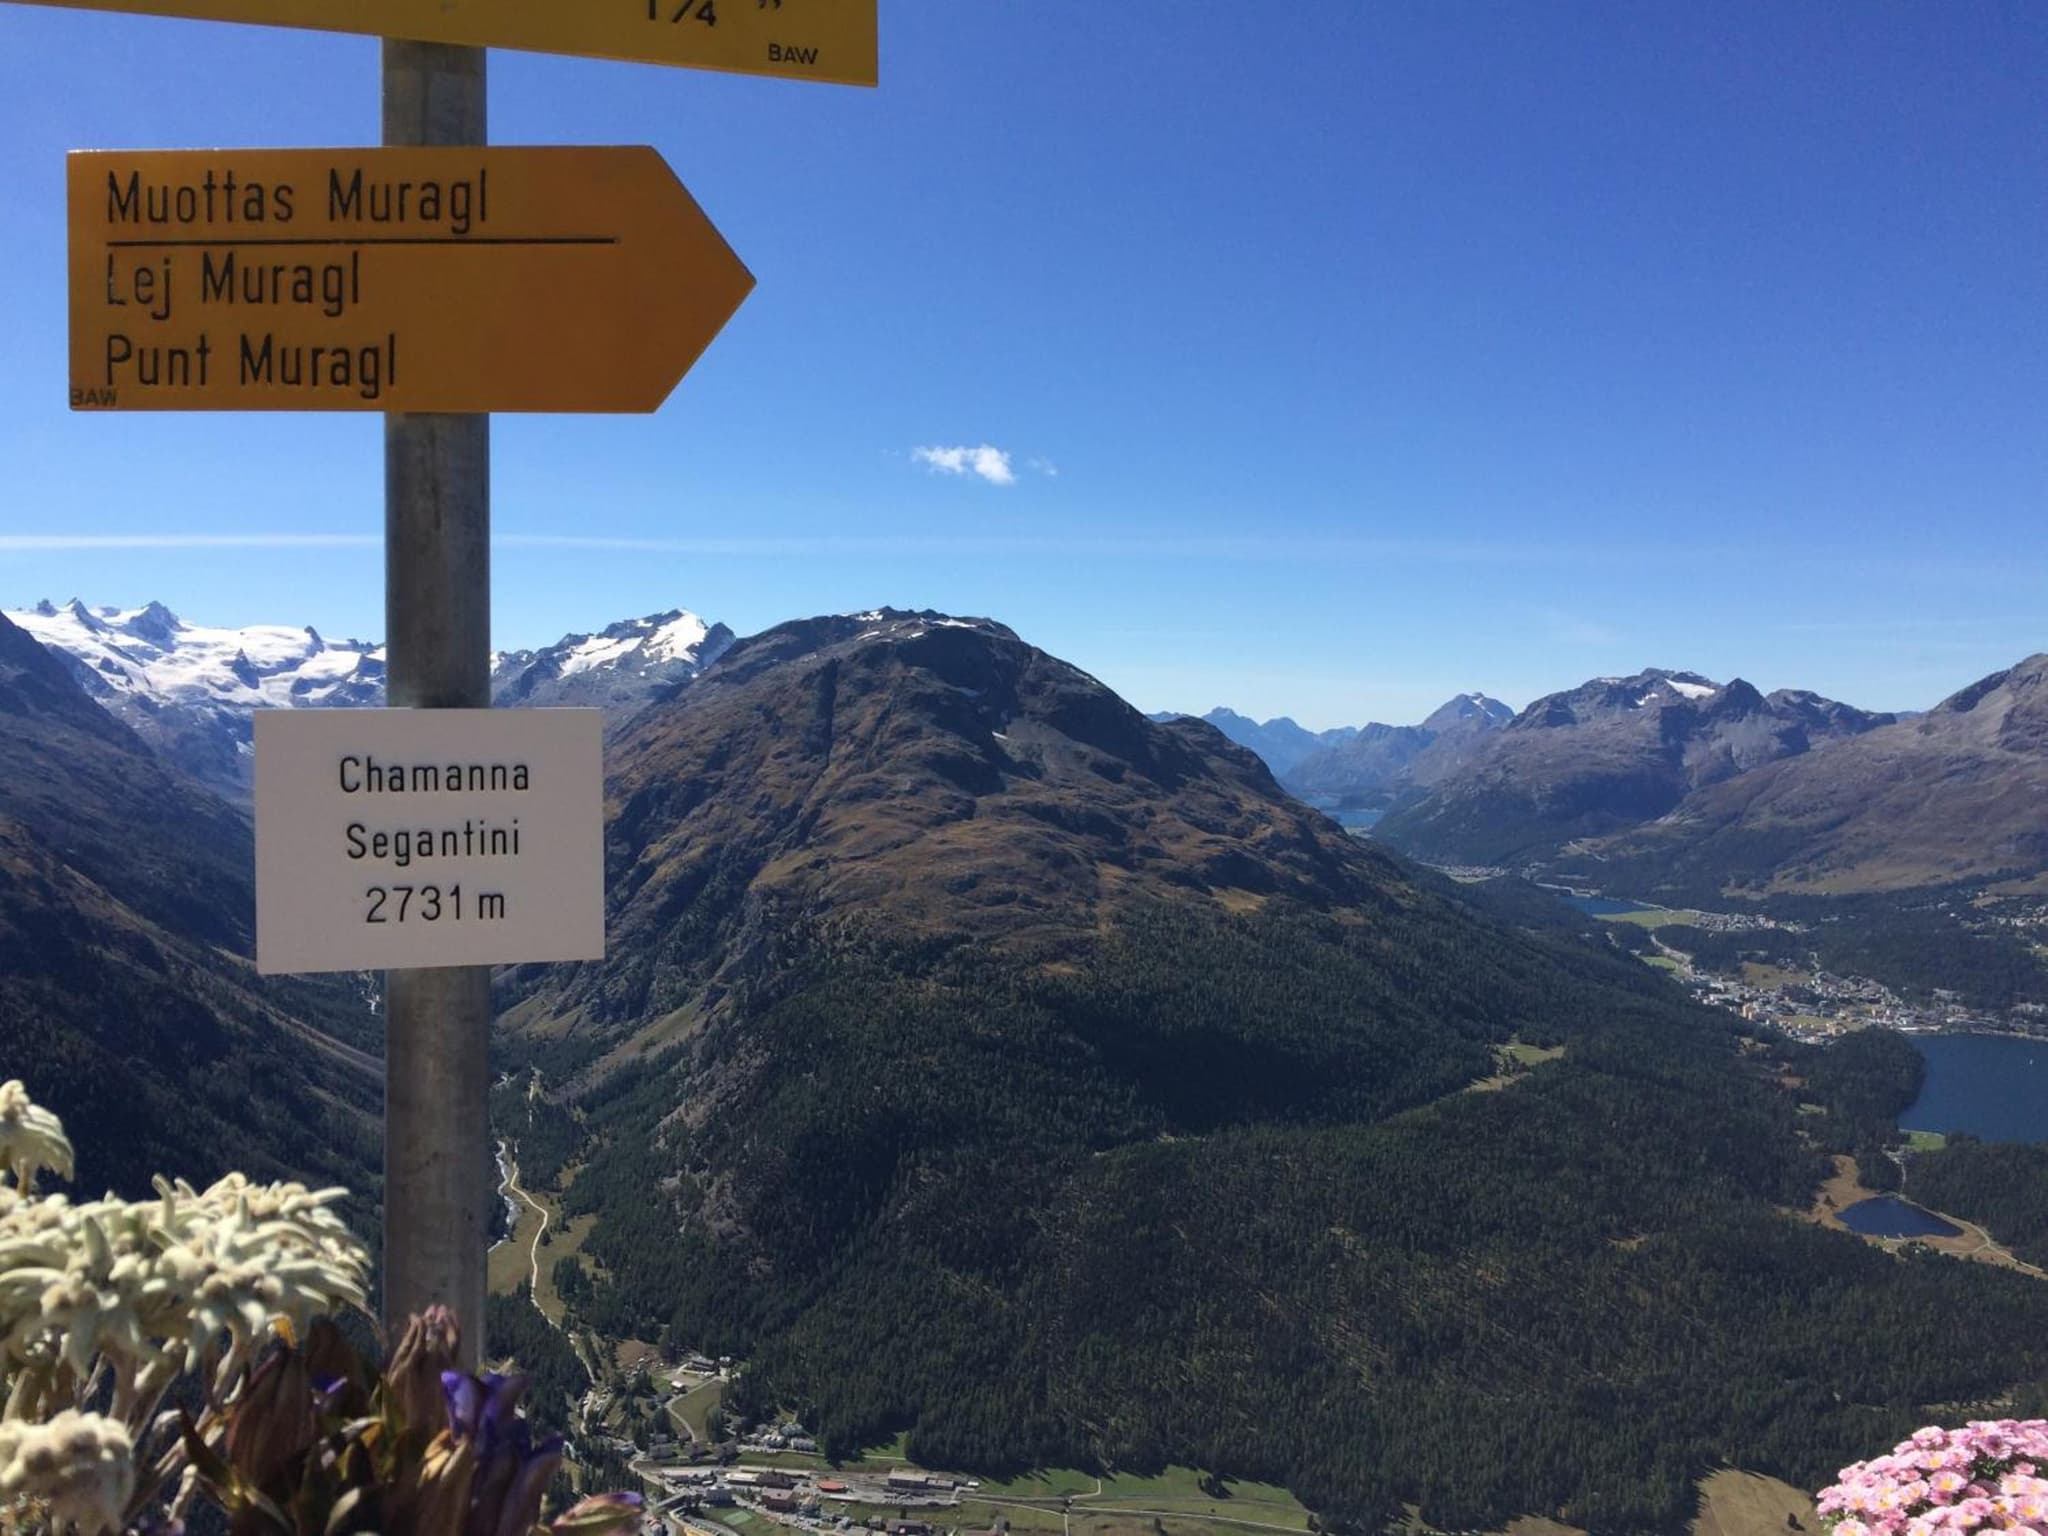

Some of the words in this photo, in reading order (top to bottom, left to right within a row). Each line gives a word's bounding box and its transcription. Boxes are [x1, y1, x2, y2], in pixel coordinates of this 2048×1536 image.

[768, 43, 819, 65] BAW
[107, 170, 294, 224] Muottas
[330, 168, 487, 234] Muragl
[107, 252, 172, 320] Lej
[203, 251, 360, 317] Muragl
[107, 334, 211, 387] Punt
[240, 333, 397, 399] Muragl
[339, 756, 530, 793] Chamanna
[346, 818, 520, 867] Segantini
[365, 883, 462, 923] 2731
[478, 892, 505, 920] m
